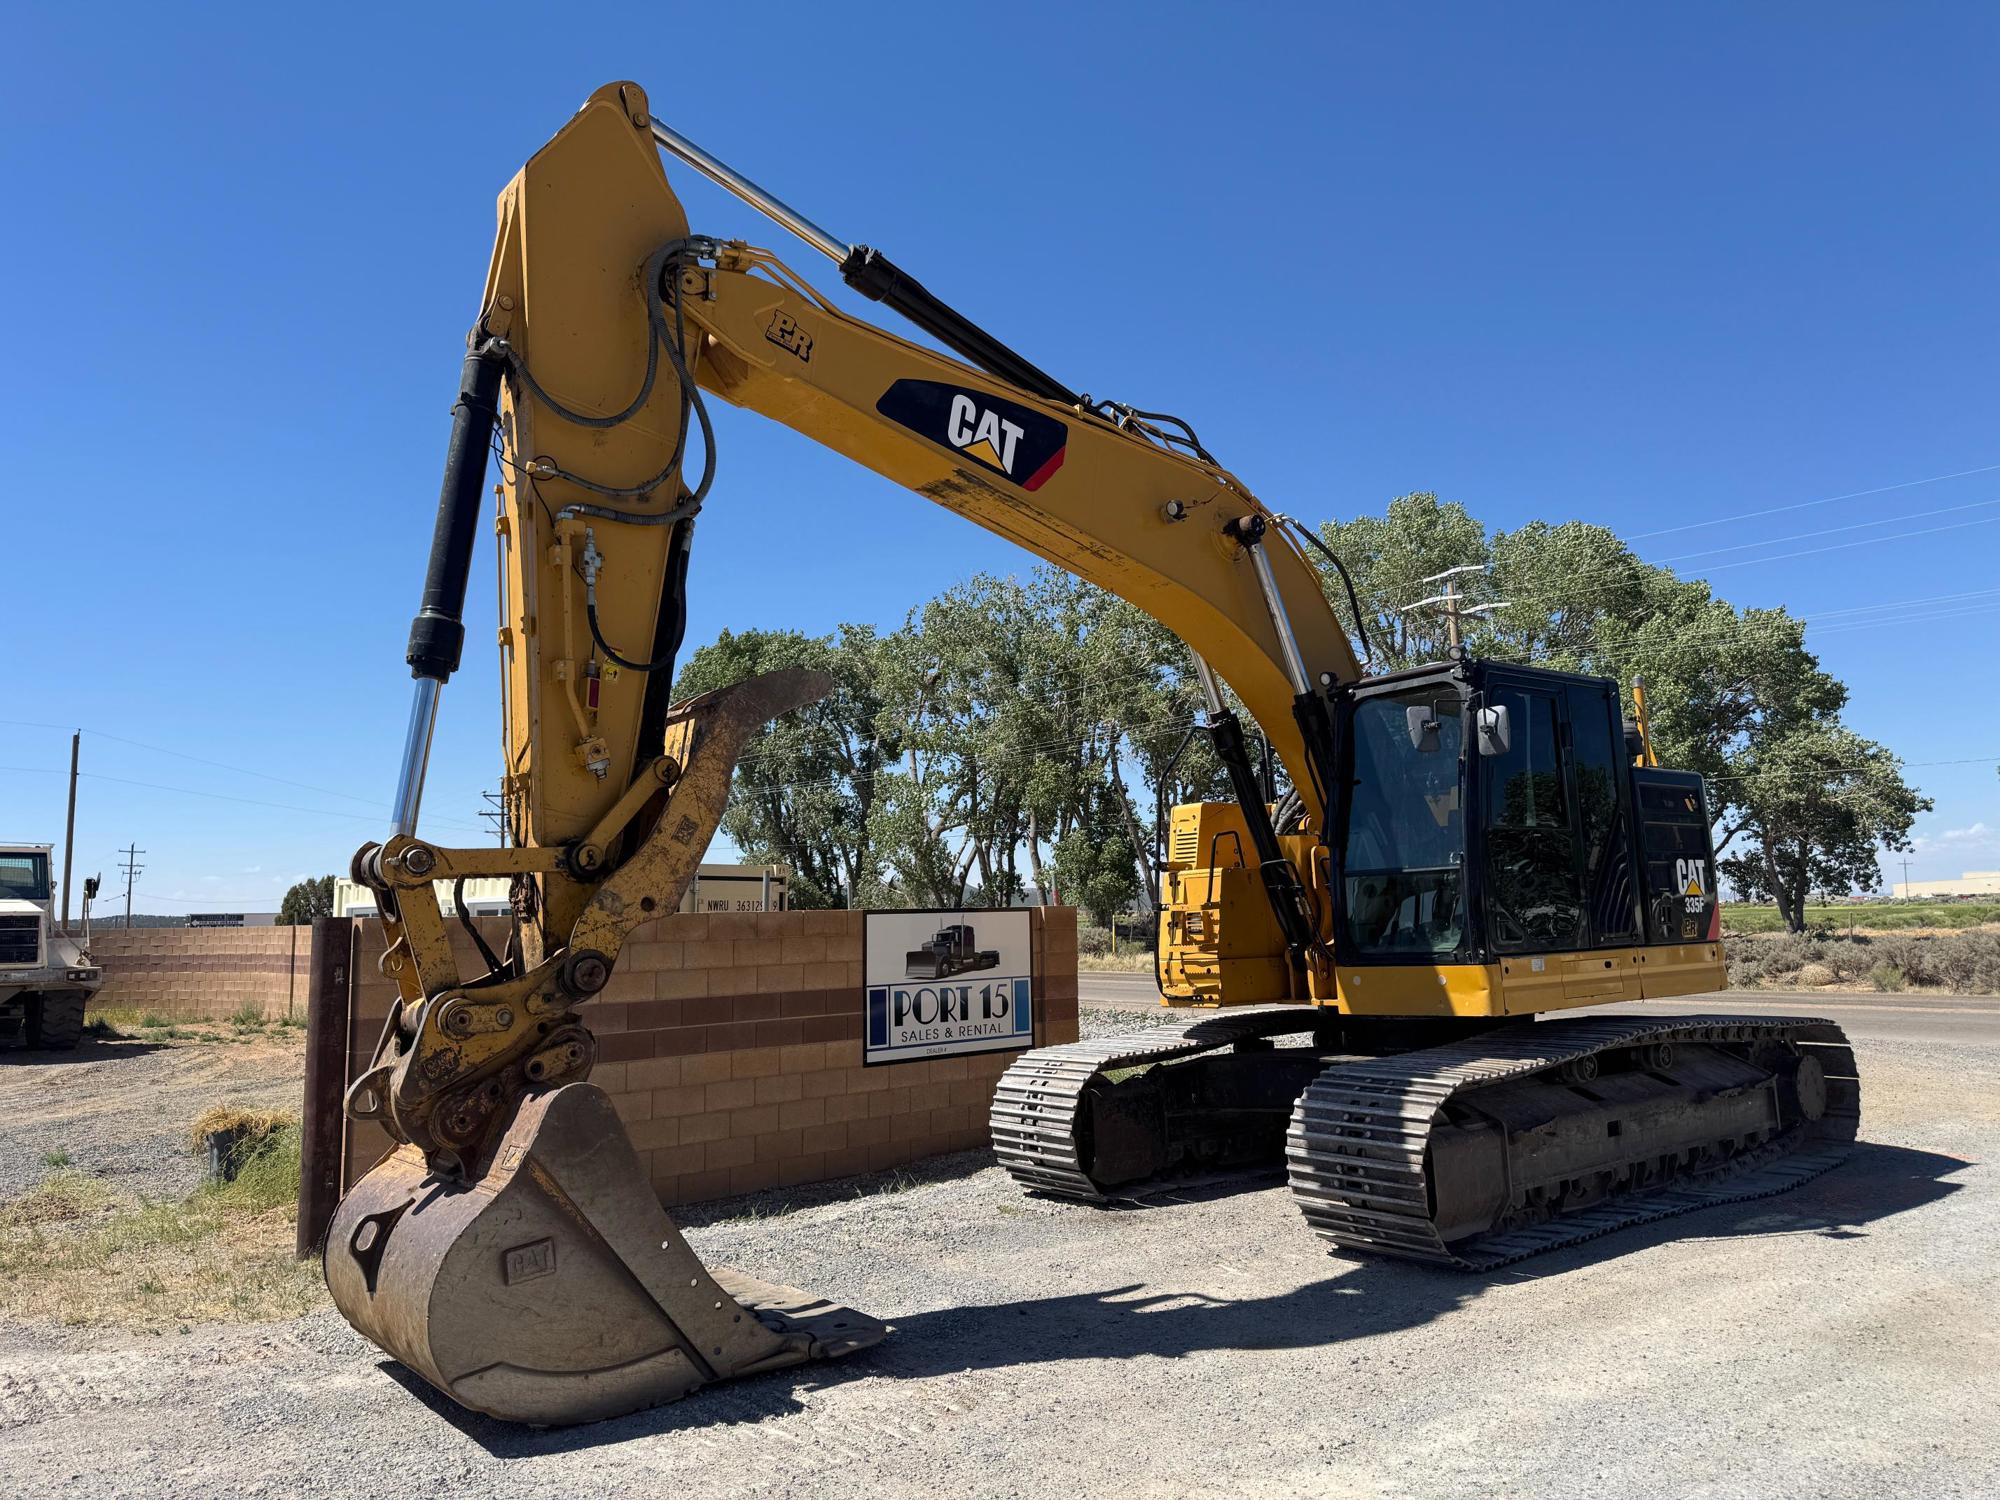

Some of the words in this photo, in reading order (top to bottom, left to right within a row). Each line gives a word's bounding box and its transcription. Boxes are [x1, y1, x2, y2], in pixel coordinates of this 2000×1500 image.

[948, 394, 1024, 475] CAT
[1676, 859, 1705, 896] CAT
[707, 900, 729, 912] NWRU
[1685, 897, 1704, 913] 335F
[894, 986, 973, 1027] PORT
[980, 983, 1009, 1019] 15
[901, 1028, 939, 1043] SALES
[944, 1027, 953, 1039] &
[959, 1022, 1004, 1037] RENTAL
[511, 1244, 550, 1274] CAT
